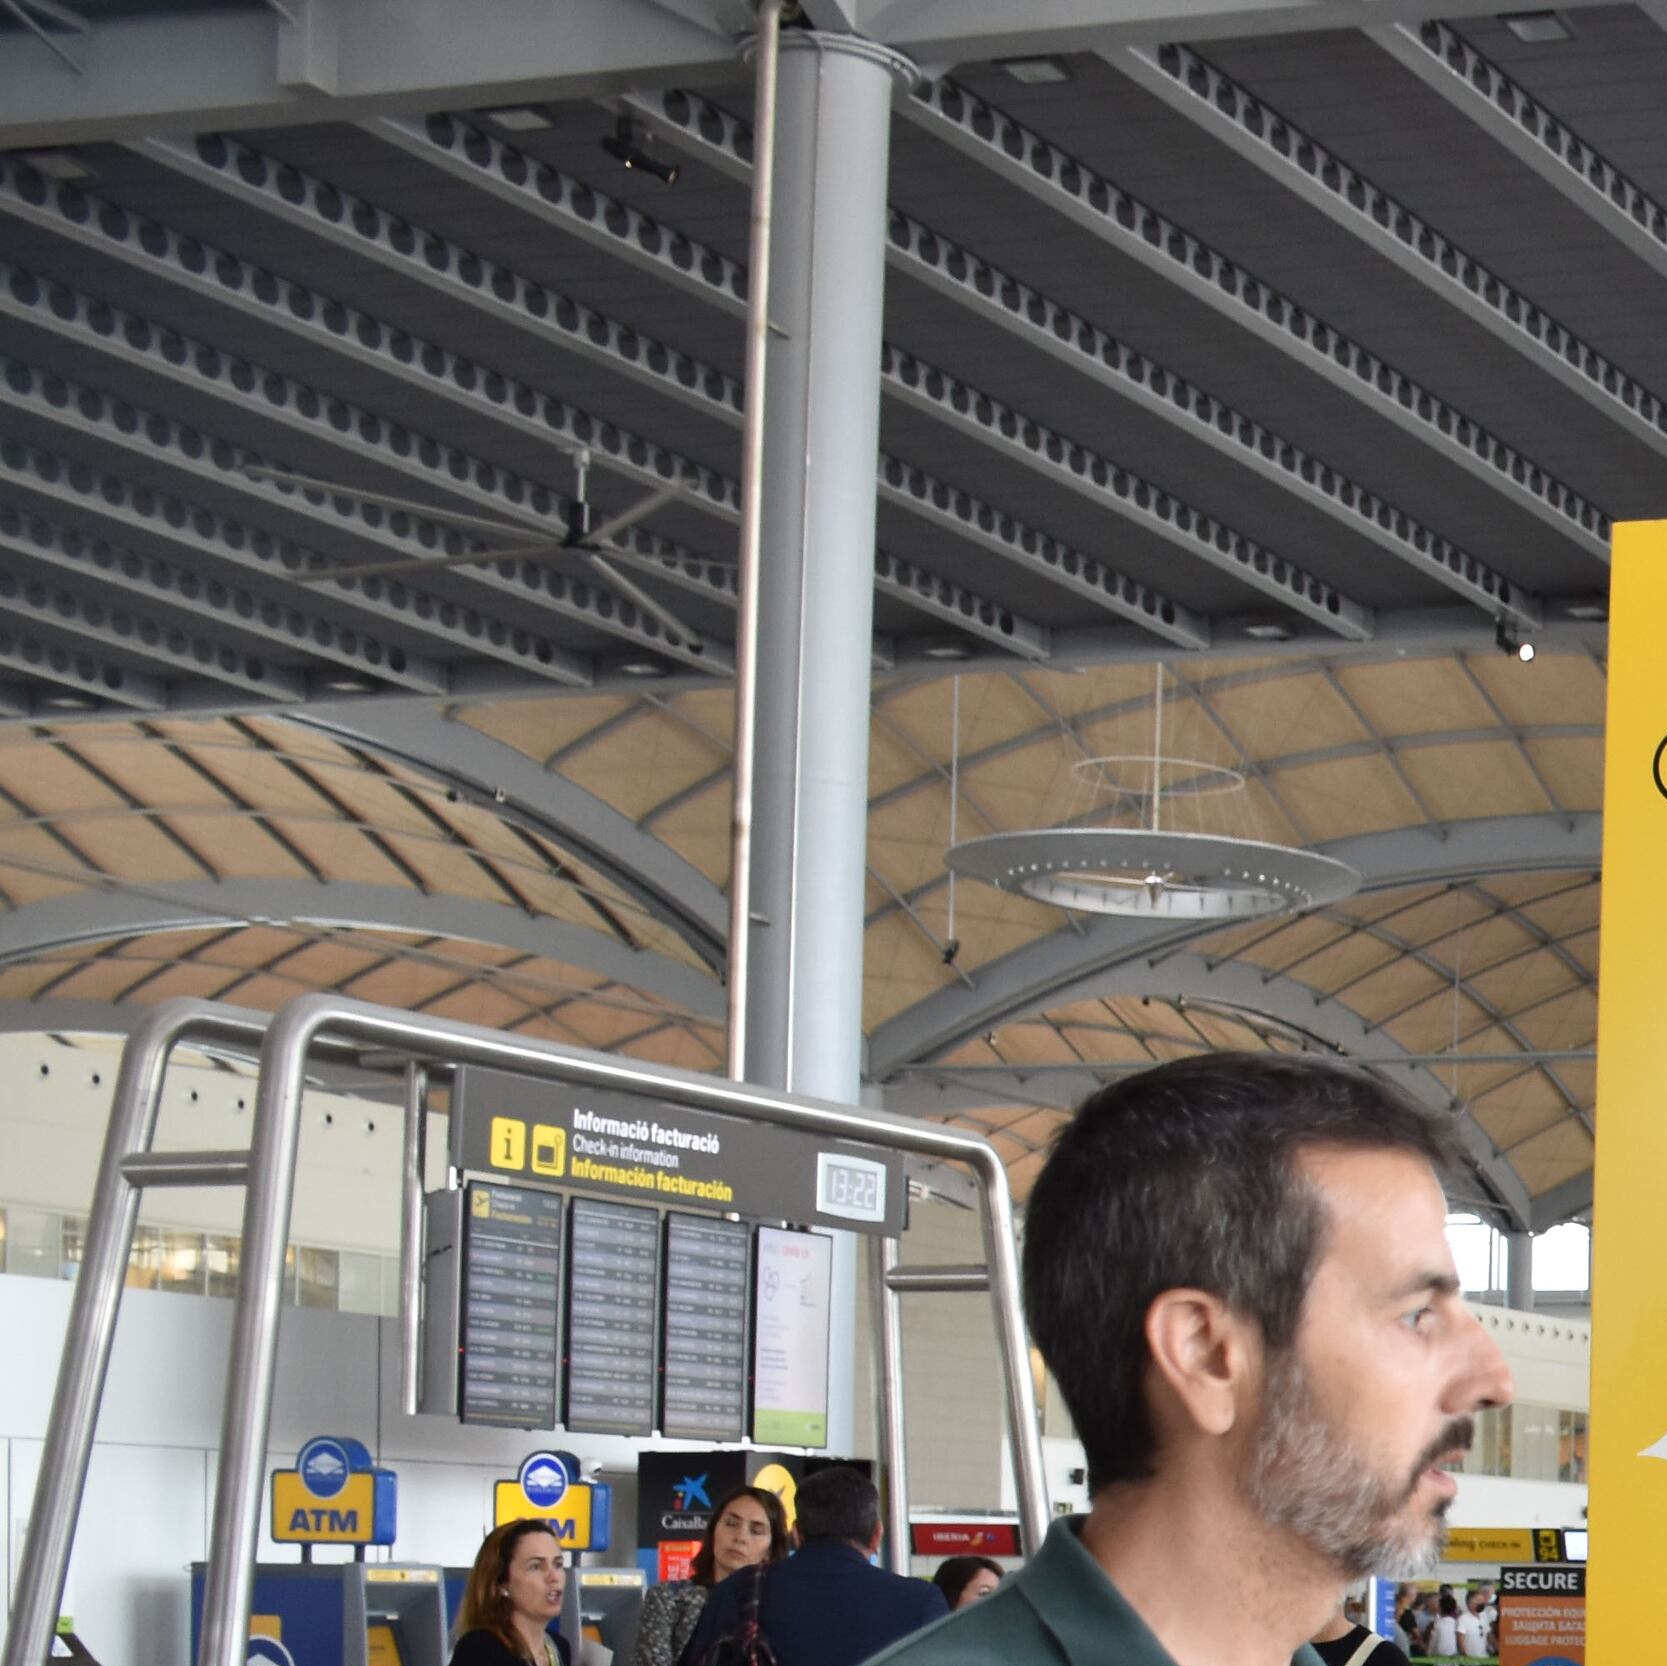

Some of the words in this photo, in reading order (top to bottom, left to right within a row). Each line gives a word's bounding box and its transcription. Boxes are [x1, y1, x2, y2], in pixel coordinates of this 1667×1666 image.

[573, 1109, 649, 1141] Informació
[651, 1121, 720, 1153] facturació
[573, 1133, 618, 1159] Check-in
[620, 1140, 679, 1169] information
[571, 1157, 654, 1189] Información
[656, 1170, 733, 1202] facturación
[831, 1168, 876, 1208] 13:22
[289, 1508, 358, 1534] ATM
[933, 1532, 970, 1542] IBERIA
[1503, 1571, 1579, 1591] SECURE
[1505, 1634, 1549, 1646] LUGGAGE
